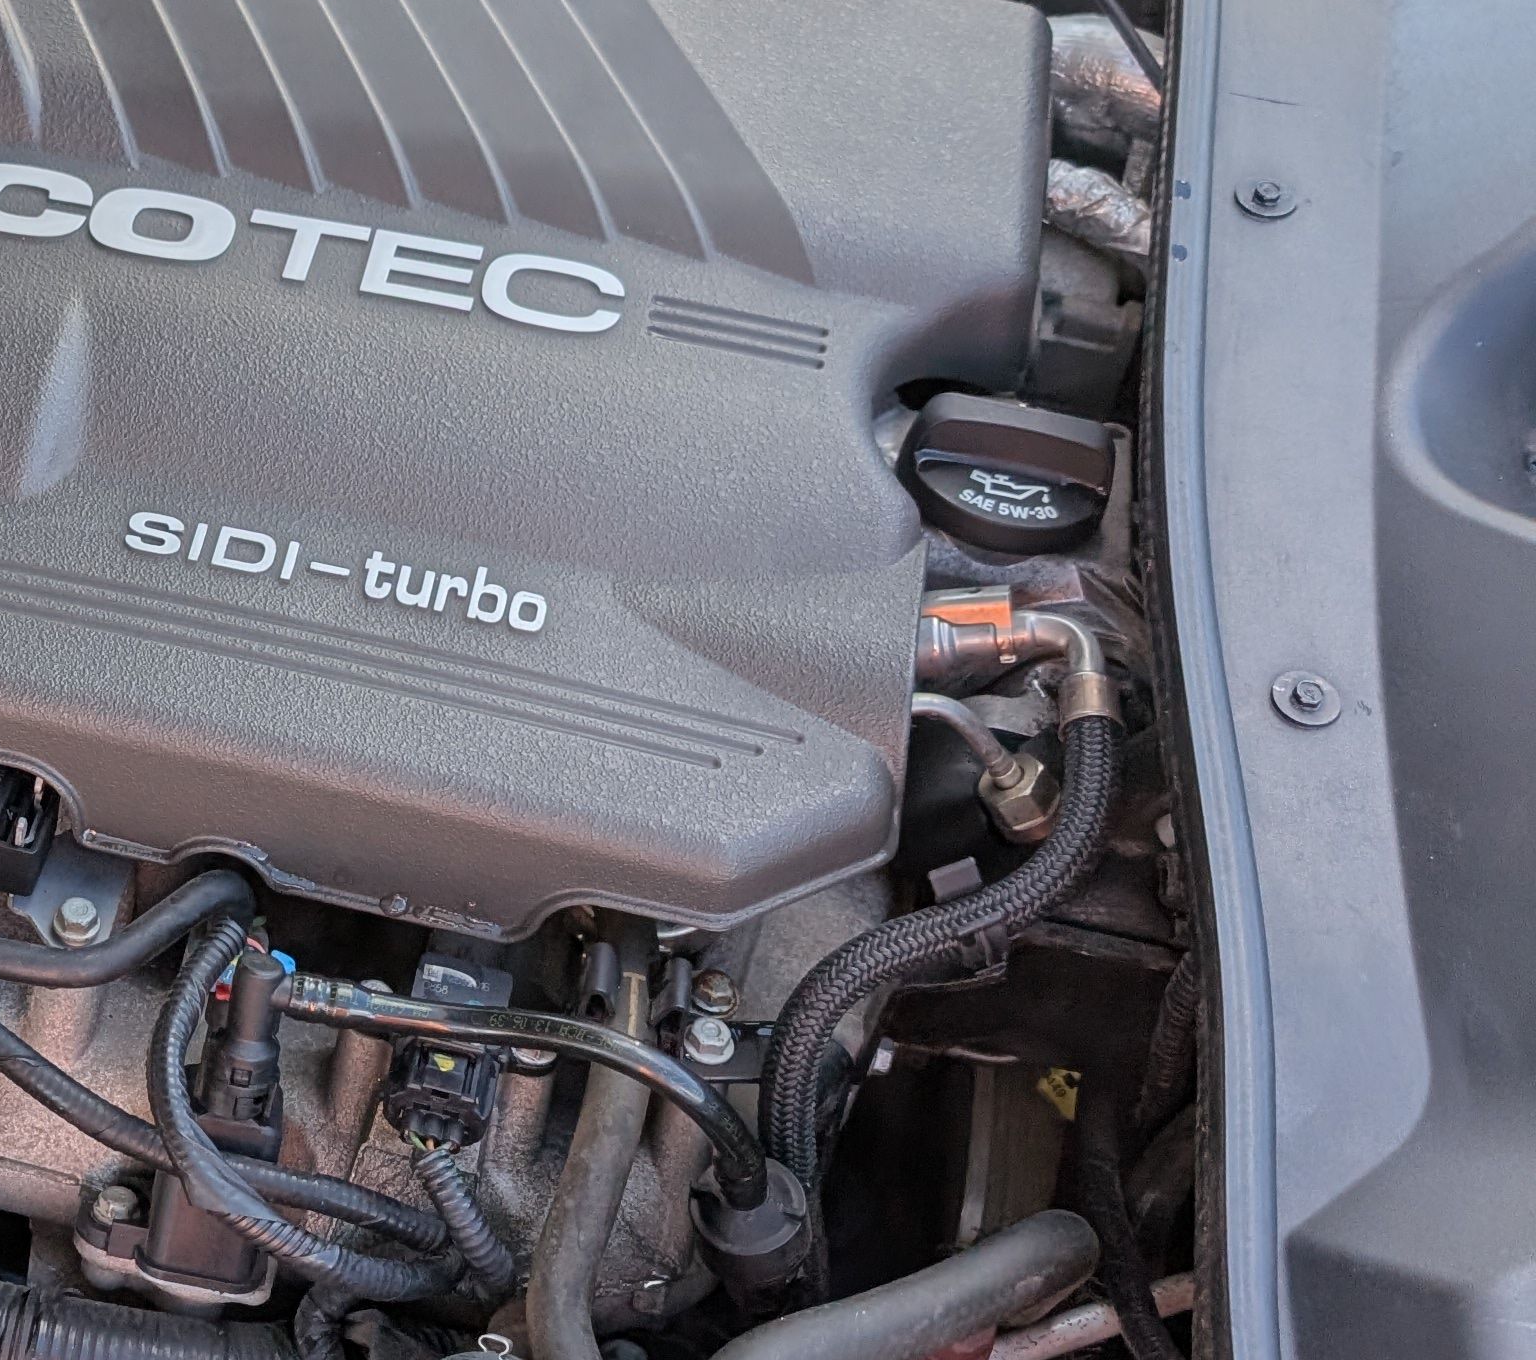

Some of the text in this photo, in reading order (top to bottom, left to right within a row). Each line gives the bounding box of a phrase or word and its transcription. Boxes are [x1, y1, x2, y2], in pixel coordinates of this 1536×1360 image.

[959, 488, 1059, 520] SAE 5W-30
[125, 511, 548, 634] SIDI-turbo
